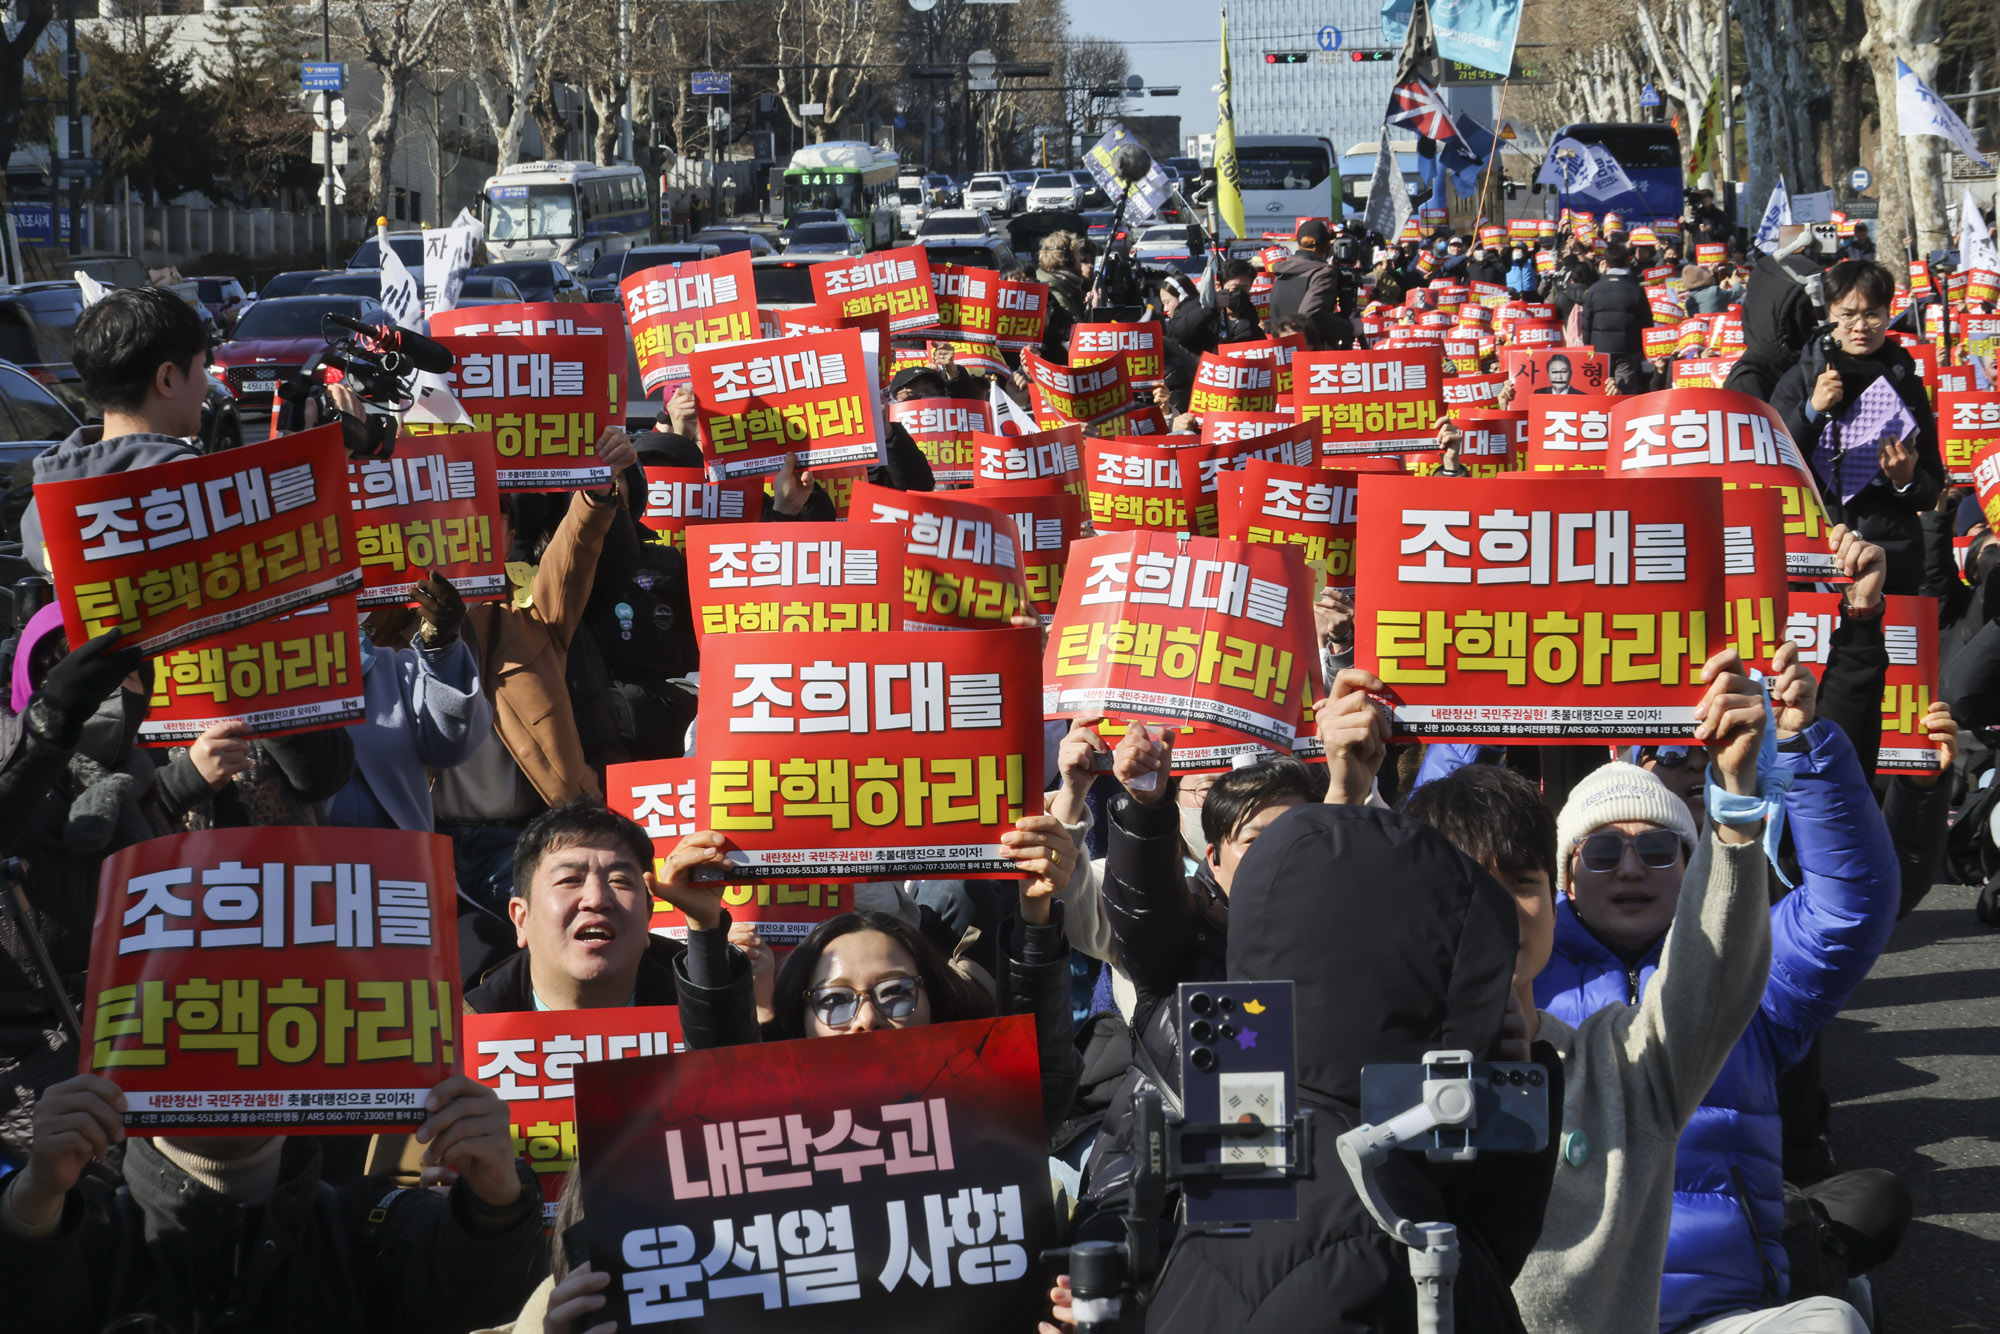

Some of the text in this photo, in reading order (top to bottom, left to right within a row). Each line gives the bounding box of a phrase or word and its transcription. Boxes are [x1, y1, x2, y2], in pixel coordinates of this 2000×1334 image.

[802, 175, 844, 185] 5413
[823, 259, 918, 298] 조희대를
[931, 273, 987, 299] 희대를
[627, 272, 739, 325] 조희대를
[842, 285, 931, 319] 핵하라!
[938, 303, 991, 330] 하라!
[1078, 331, 1155, 353] 조희대를
[443, 353, 585, 398] 희대를
[711, 349, 848, 403] 조희대를
[1034, 361, 1119, 395] 조희대를
[1199, 360, 1272, 391] 조희대를
[1309, 361, 1428, 395] 조희대를
[1443, 381, 1505, 404] 조희대를
[1514, 360, 1603, 387] 사 형
[709, 394, 865, 455] 탄핵하라!
[896, 407, 985, 435] 조희대를
[1302, 400, 1438, 435] 탄핵하라!
[1458, 430, 1507, 456] 대를
[1621, 408, 1806, 472] 조희대를
[980, 441, 1080, 480] 조희대를
[76, 463, 316, 562] 조희대를
[645, 480, 746, 519] 희대를
[356, 515, 493, 571] 핵하라!
[1398, 508, 1686, 586] 조희대를
[74, 514, 343, 643] 탄핵하라!
[709, 540, 879, 590] 조희대를
[1081, 550, 1290, 628] 조희대를
[1055, 618, 1294, 706] 탄핵하라!
[1375, 608, 1708, 686] 탄핵하라!
[729, 660, 1004, 734] 조희대를
[1117, 689, 1169, 706] 국민주권실현!
[1170, 696, 1225, 714] 촛불대행진으로
[1226, 707, 1253, 721] 모이자!
[1431, 708, 1662, 721] 내란청산! 국민주권실현! 촛불대행진으로 모이자!
[1424, 723, 1438, 733] 신한
[1441, 724, 1501, 733] 100-036-551308
[1502, 724, 1560, 734] 촛불승리전환행동
[1568, 726, 1584, 734] ARS
[1172, 749, 1210, 759] 민주권실현!
[708, 754, 1024, 831] 탄핵하라!
[755, 867, 769, 876] 신한
[772, 866, 828, 876] 100-036-551308
[830, 864, 887, 873] 촛불승리전환행동
[893, 863, 908, 872] ARS
[761, 846, 983, 864] 내란청산! 국민주권실현! 촛불대행진으로 모이자!
[119, 861, 432, 956] 조희대를
[92, 978, 456, 1070] 탄핵하라!
[124, 1114, 133, 1124] 원
[140, 1114, 157, 1124] 신한
[160, 1113, 230, 1123] 100-036-551308
[232, 1112, 299, 1123] 촛불승리전환행동
[307, 1111, 325, 1121] ARS
[149, 1092, 416, 1109] 내란청산! 국민주권실현! 촛불대행진으로 모이자!
[666, 1097, 955, 1201] 내란수괴
[621, 1184, 1028, 1326] 윤석열 사형
